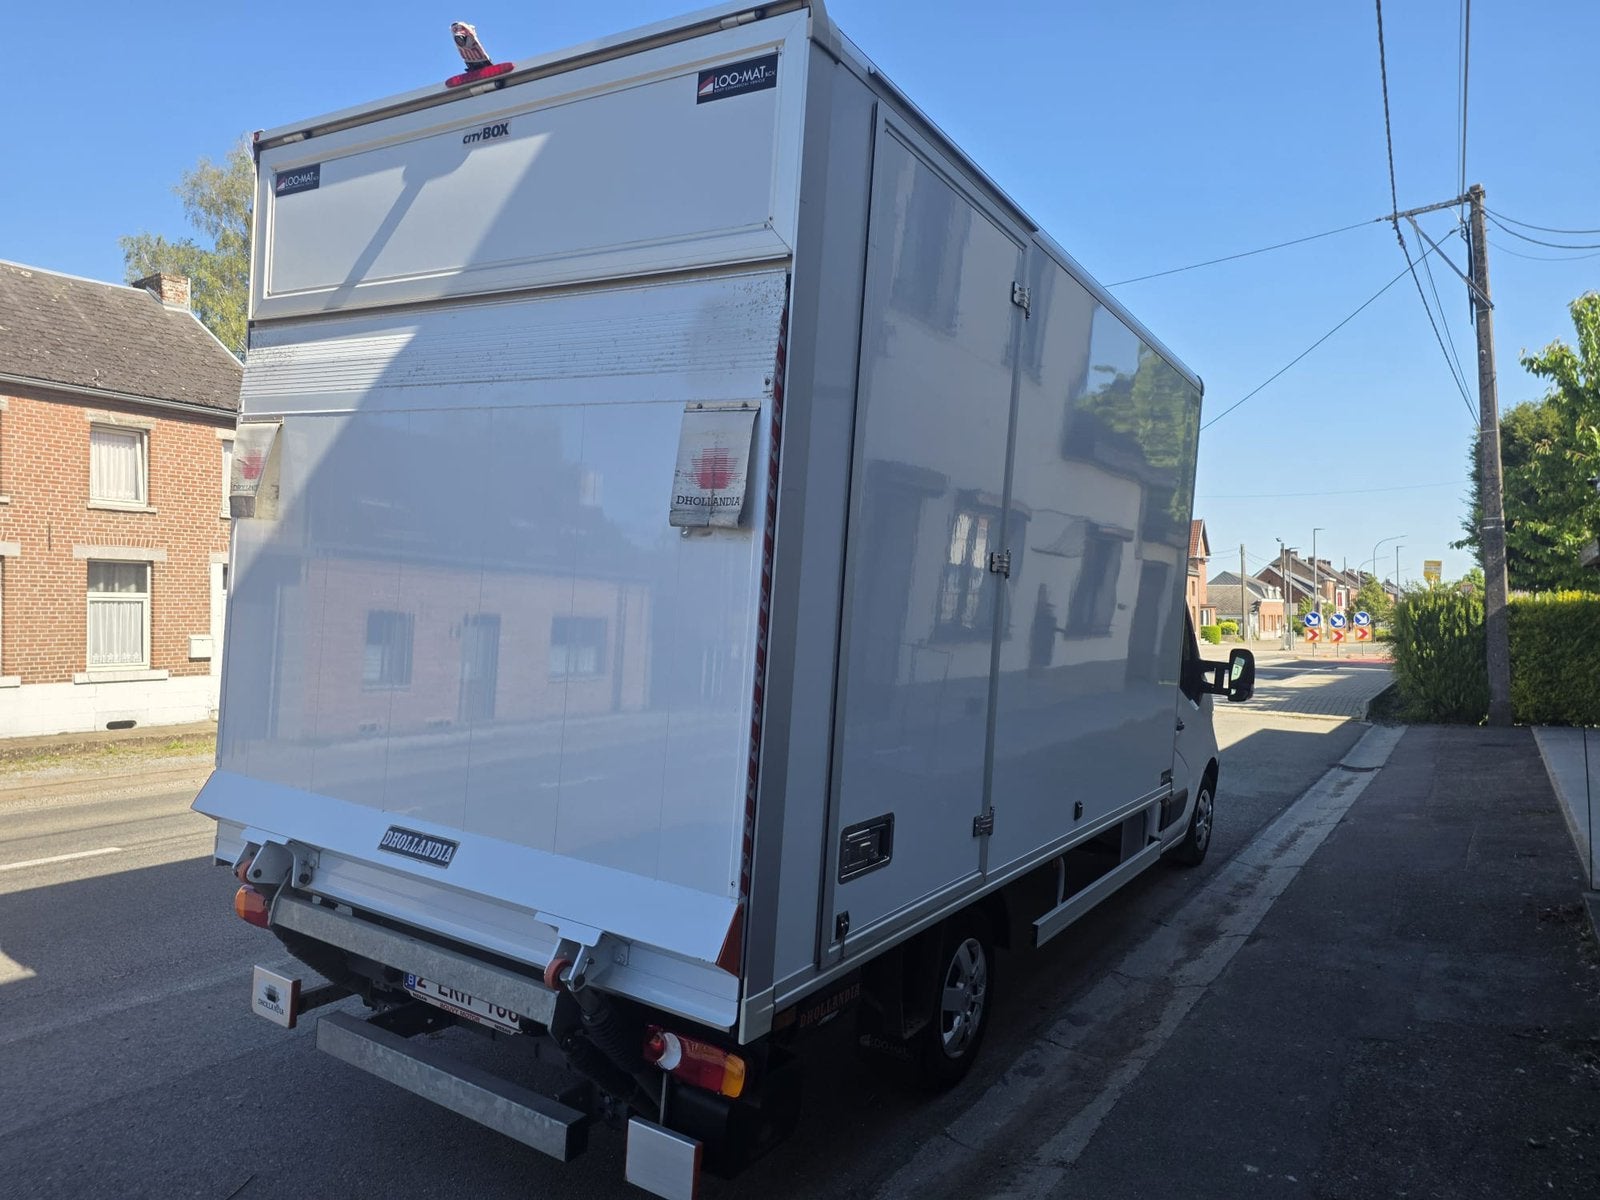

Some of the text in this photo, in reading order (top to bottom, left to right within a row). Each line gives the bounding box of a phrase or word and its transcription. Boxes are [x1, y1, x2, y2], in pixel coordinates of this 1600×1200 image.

[714, 66, 766, 89] LOO-MAT
[285, 171, 314, 187] LOO-MAT
[675, 495, 741, 507] DHOLLANDIA
[381, 830, 454, 862] DHOLLANDIA
[800, 983, 860, 1026] DHOLLANDIA
